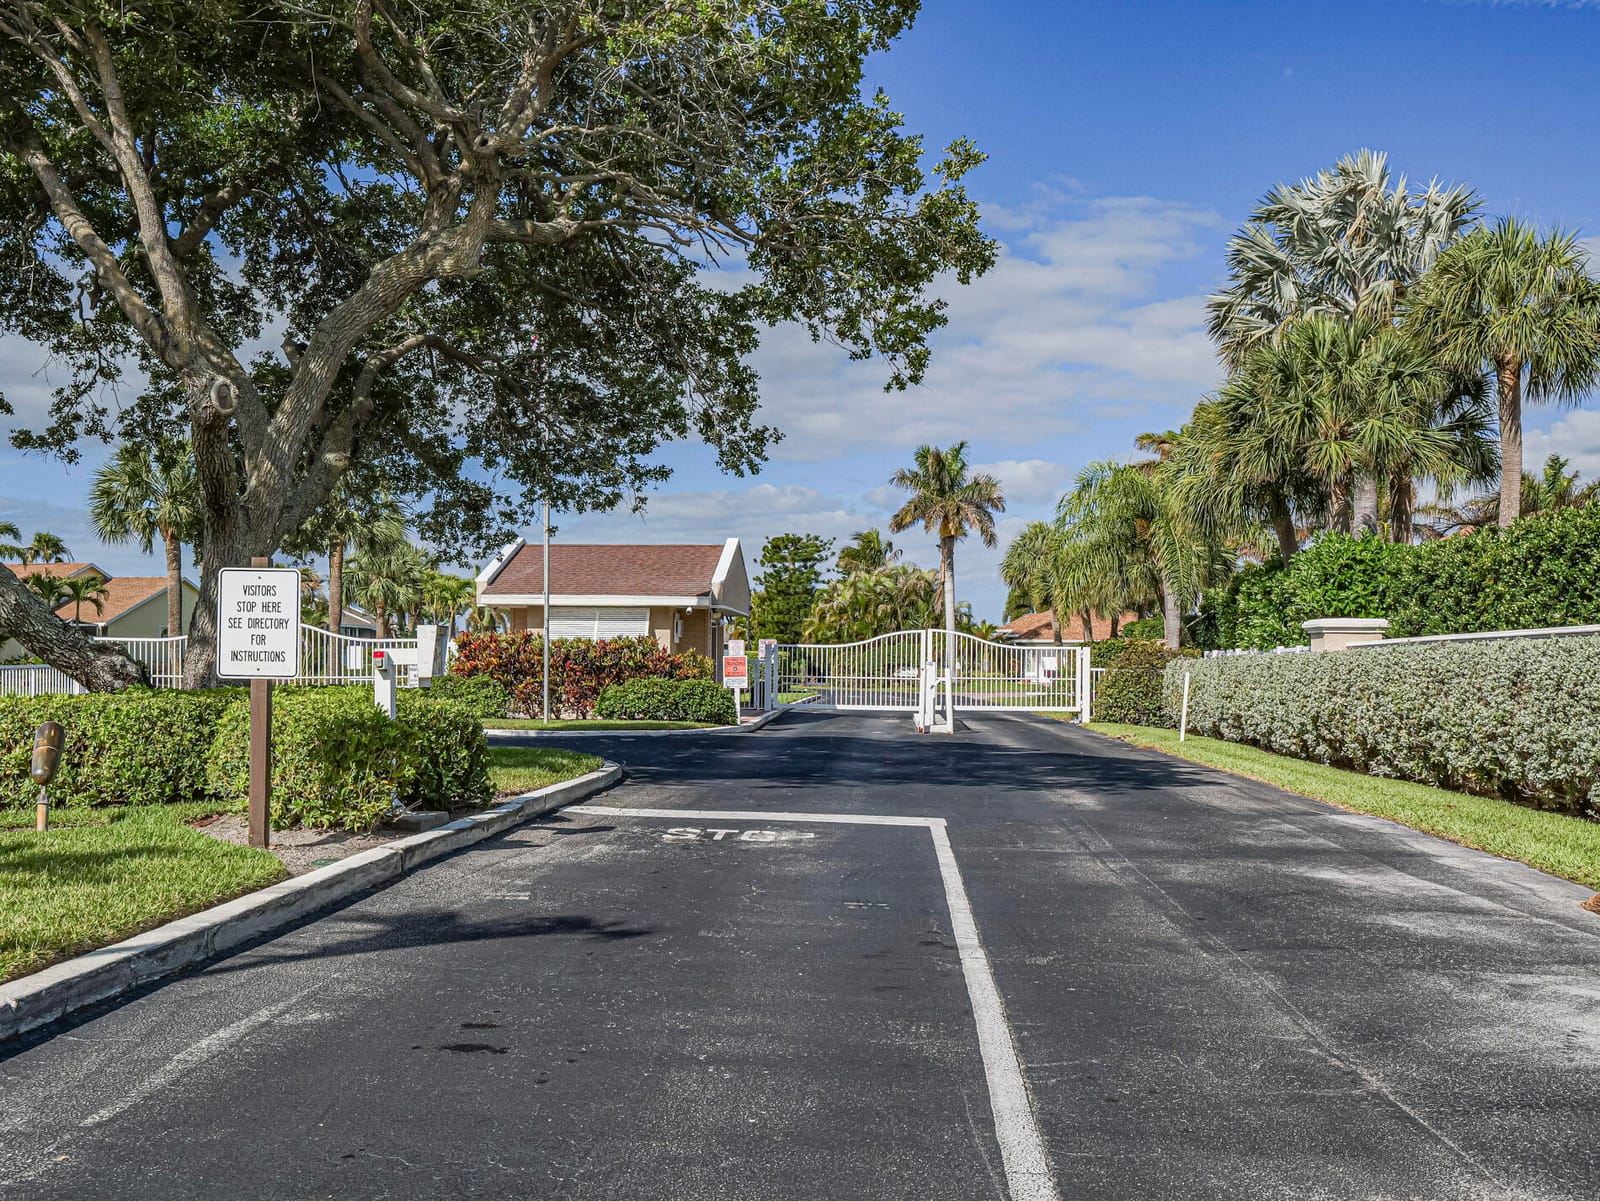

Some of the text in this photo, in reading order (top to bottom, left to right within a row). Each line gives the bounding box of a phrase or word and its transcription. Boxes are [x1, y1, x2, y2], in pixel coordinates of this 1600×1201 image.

[243, 585, 277, 596] VISITORS
[236, 601, 282, 613] STOP HERE
[228, 617, 290, 629] SEE DIRECTORY
[250, 634, 267, 646] FOR
[230, 650, 286, 662] INSTRUCTIONS
